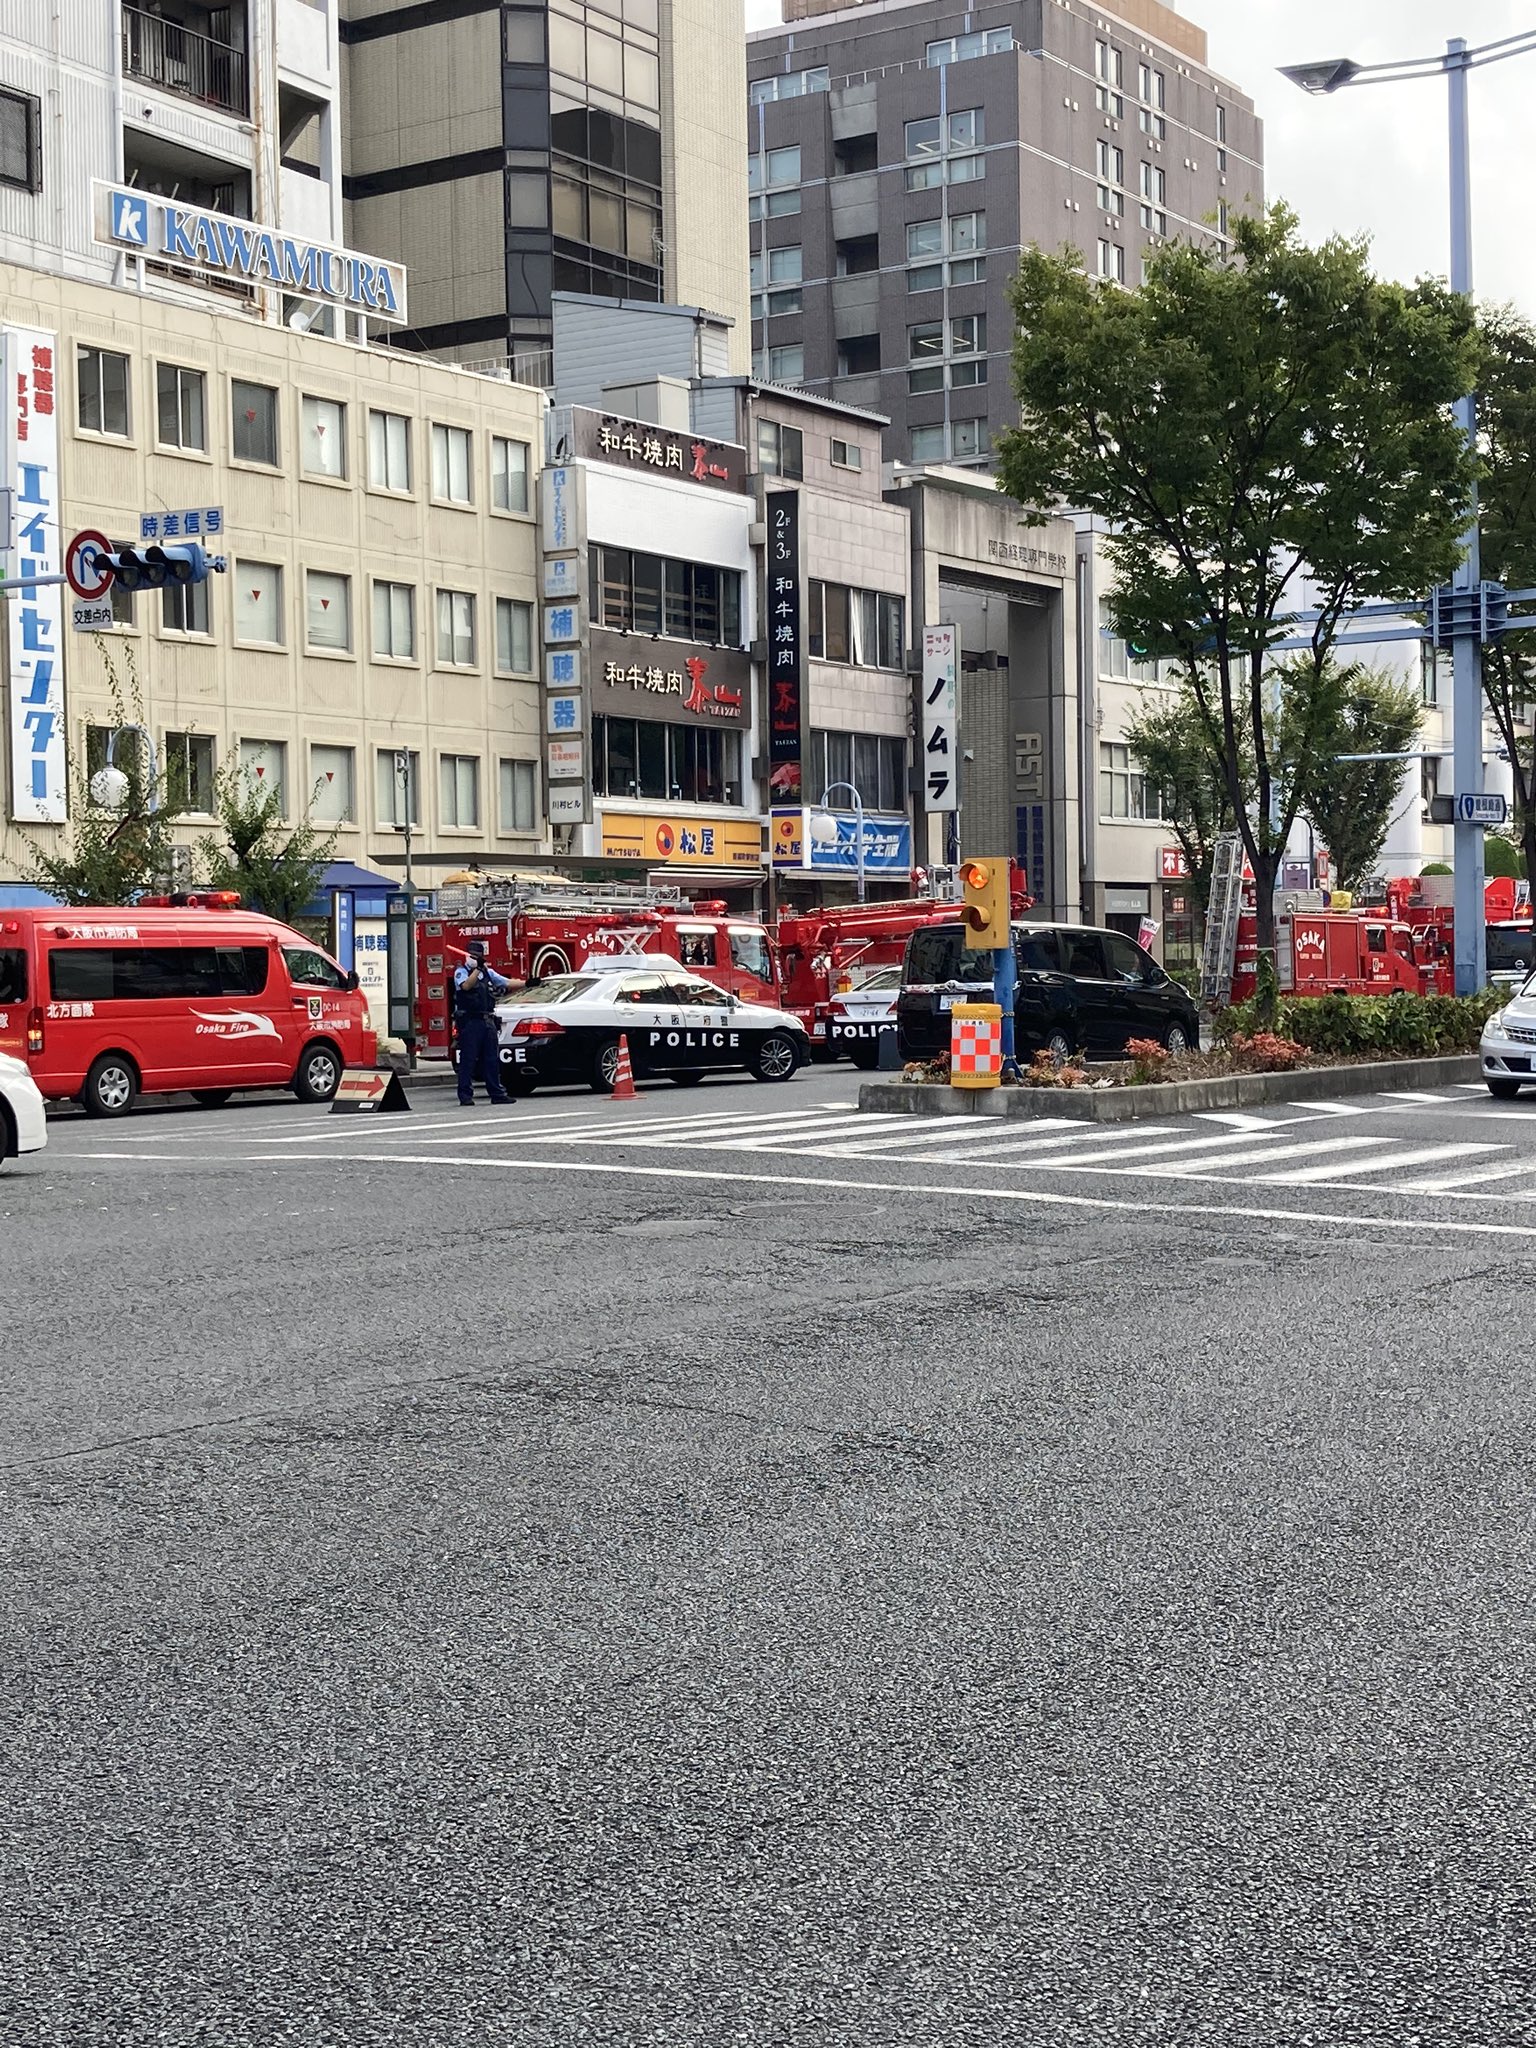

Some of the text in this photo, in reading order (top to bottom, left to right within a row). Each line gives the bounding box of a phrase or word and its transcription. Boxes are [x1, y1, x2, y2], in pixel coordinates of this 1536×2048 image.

[160, 206, 400, 312] KAWAMURA
[32, 345, 54, 415] 補聴器
[600, 426, 683, 471] 和牛焼肉
[142, 511, 221, 537] 時差信号
[775, 509, 791, 527] 2F
[776, 542, 792, 560] 3F
[74, 608, 111, 624] 交差点内
[775, 577, 795, 666] 和牛焼肉
[17, 462, 56, 799] エイドセンター
[550, 609, 576, 729] 補聴器
[605, 661, 683, 695] 和牛焼肉
[926, 677, 951, 800] ノムラ
[552, 800, 581, 810] 川村ビル
[679, 827, 715, 856] 松屋
[774, 840, 801, 855] 松屋
[70, 926, 139, 940] 大阪市消防局
[458, 925, 499, 936] 大阪市消防局
[580, 932, 615, 952] OSAKA
[1296, 930, 1326, 953] OSAKA
[47, 1002, 95, 1018] 北方面隊
[195, 1023, 249, 1034] Osaka Fire
[653, 1014, 728, 1027] 大阪府警
[650, 1032, 739, 1047] POLICE
